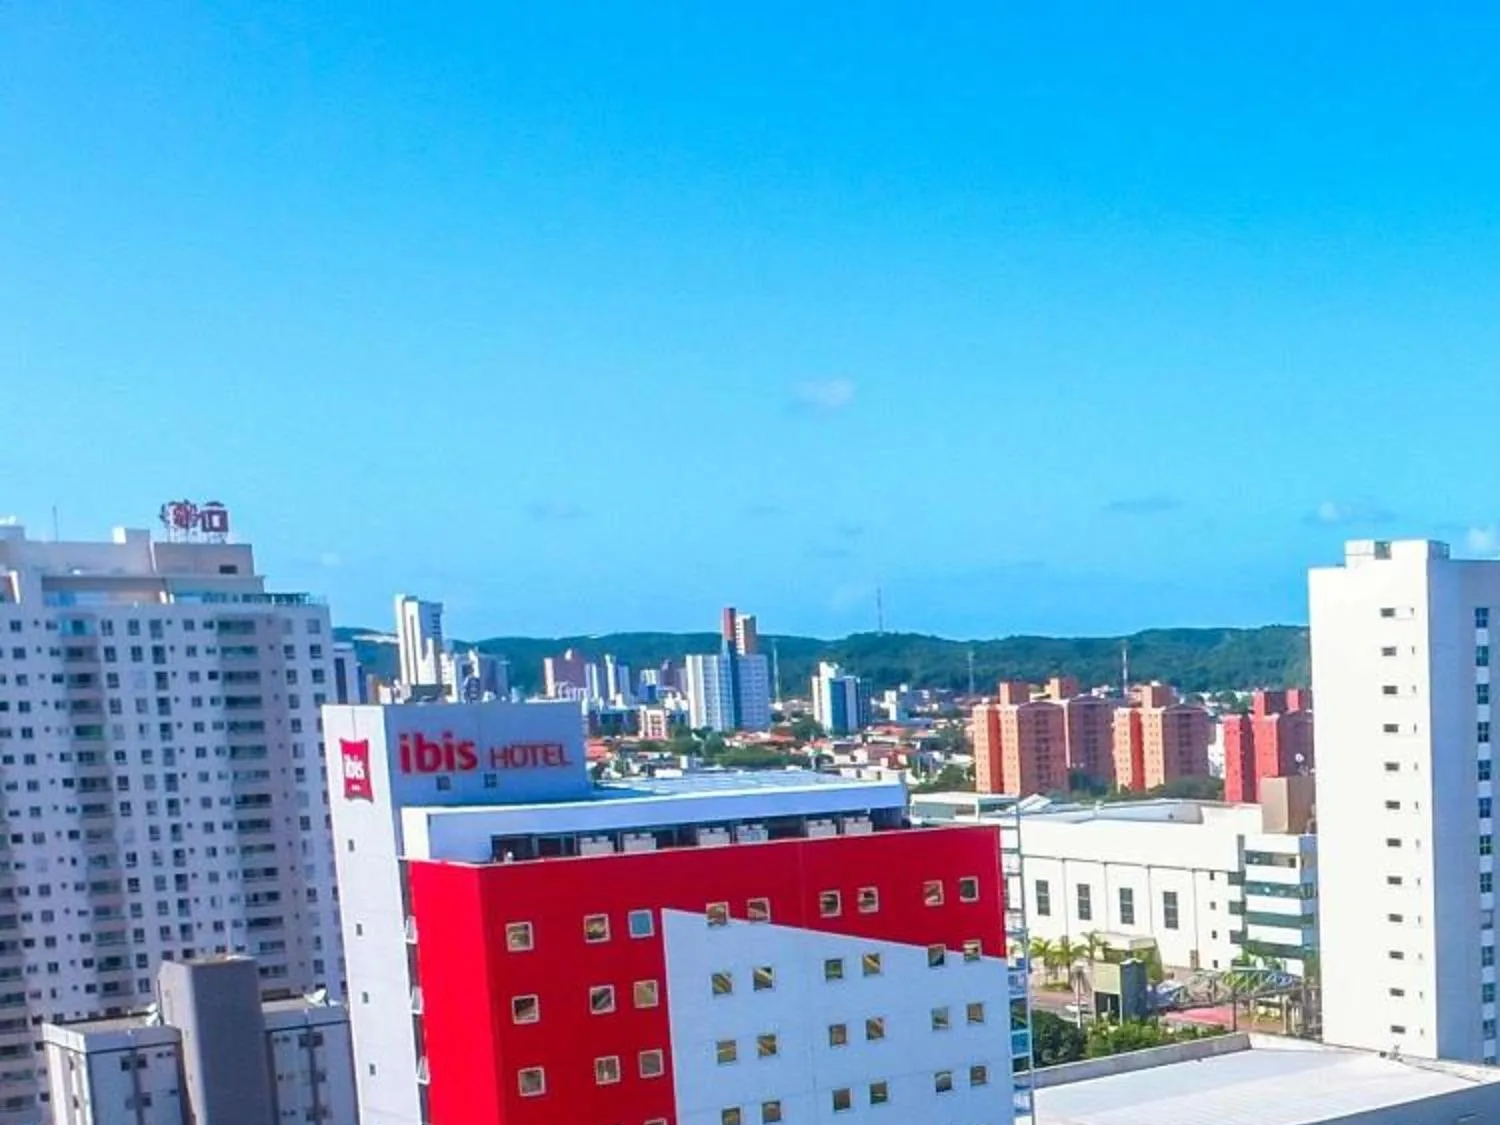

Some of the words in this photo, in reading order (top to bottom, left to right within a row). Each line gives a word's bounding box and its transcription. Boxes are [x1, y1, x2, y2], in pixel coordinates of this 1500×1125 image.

[343, 753, 366, 779] ibis
[399, 731, 478, 774] ibis
[490, 743, 573, 769] HOTEL
